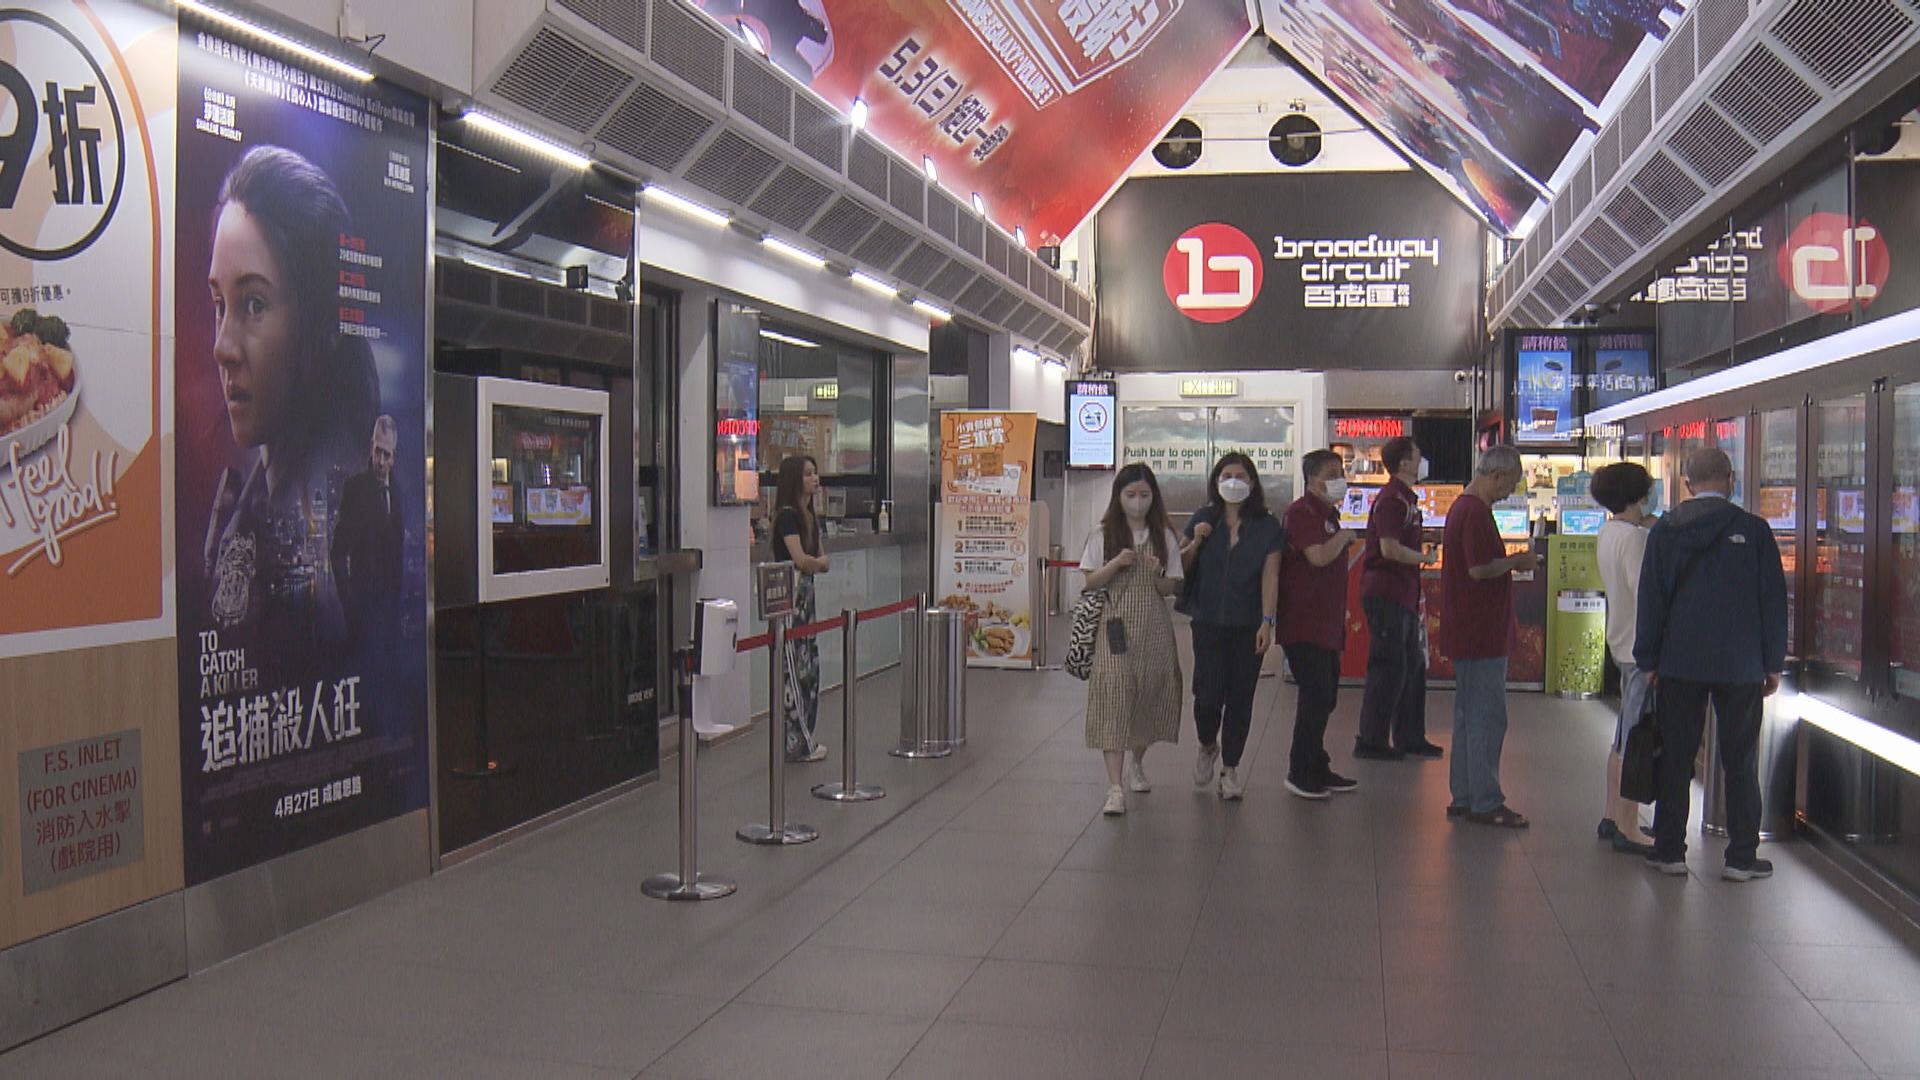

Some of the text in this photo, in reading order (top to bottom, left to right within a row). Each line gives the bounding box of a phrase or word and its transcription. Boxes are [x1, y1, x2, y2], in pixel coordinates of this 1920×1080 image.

[0, 60, 103, 208] 9折
[1274, 234, 1438, 266] broadway
[1301, 258, 1410, 281] circuit
[1335, 419, 1403, 437] POPCORN
[1124, 446, 1148, 457] Push
[1150, 446, 1165, 457] bar
[1169, 446, 1178, 457] to
[1181, 448, 1206, 459] open
[1258, 446, 1268, 457] to
[199, 630, 218, 653] TO
[200, 648, 245, 675] CATCH
[200, 676, 211, 699] A
[200, 676, 362, 773] 追捕殺人狂
[44, 738, 122, 774] F.S. INLET
[27, 767, 137, 816] (FOR CINEMA)
[274, 788, 319, 818] 4月27日
